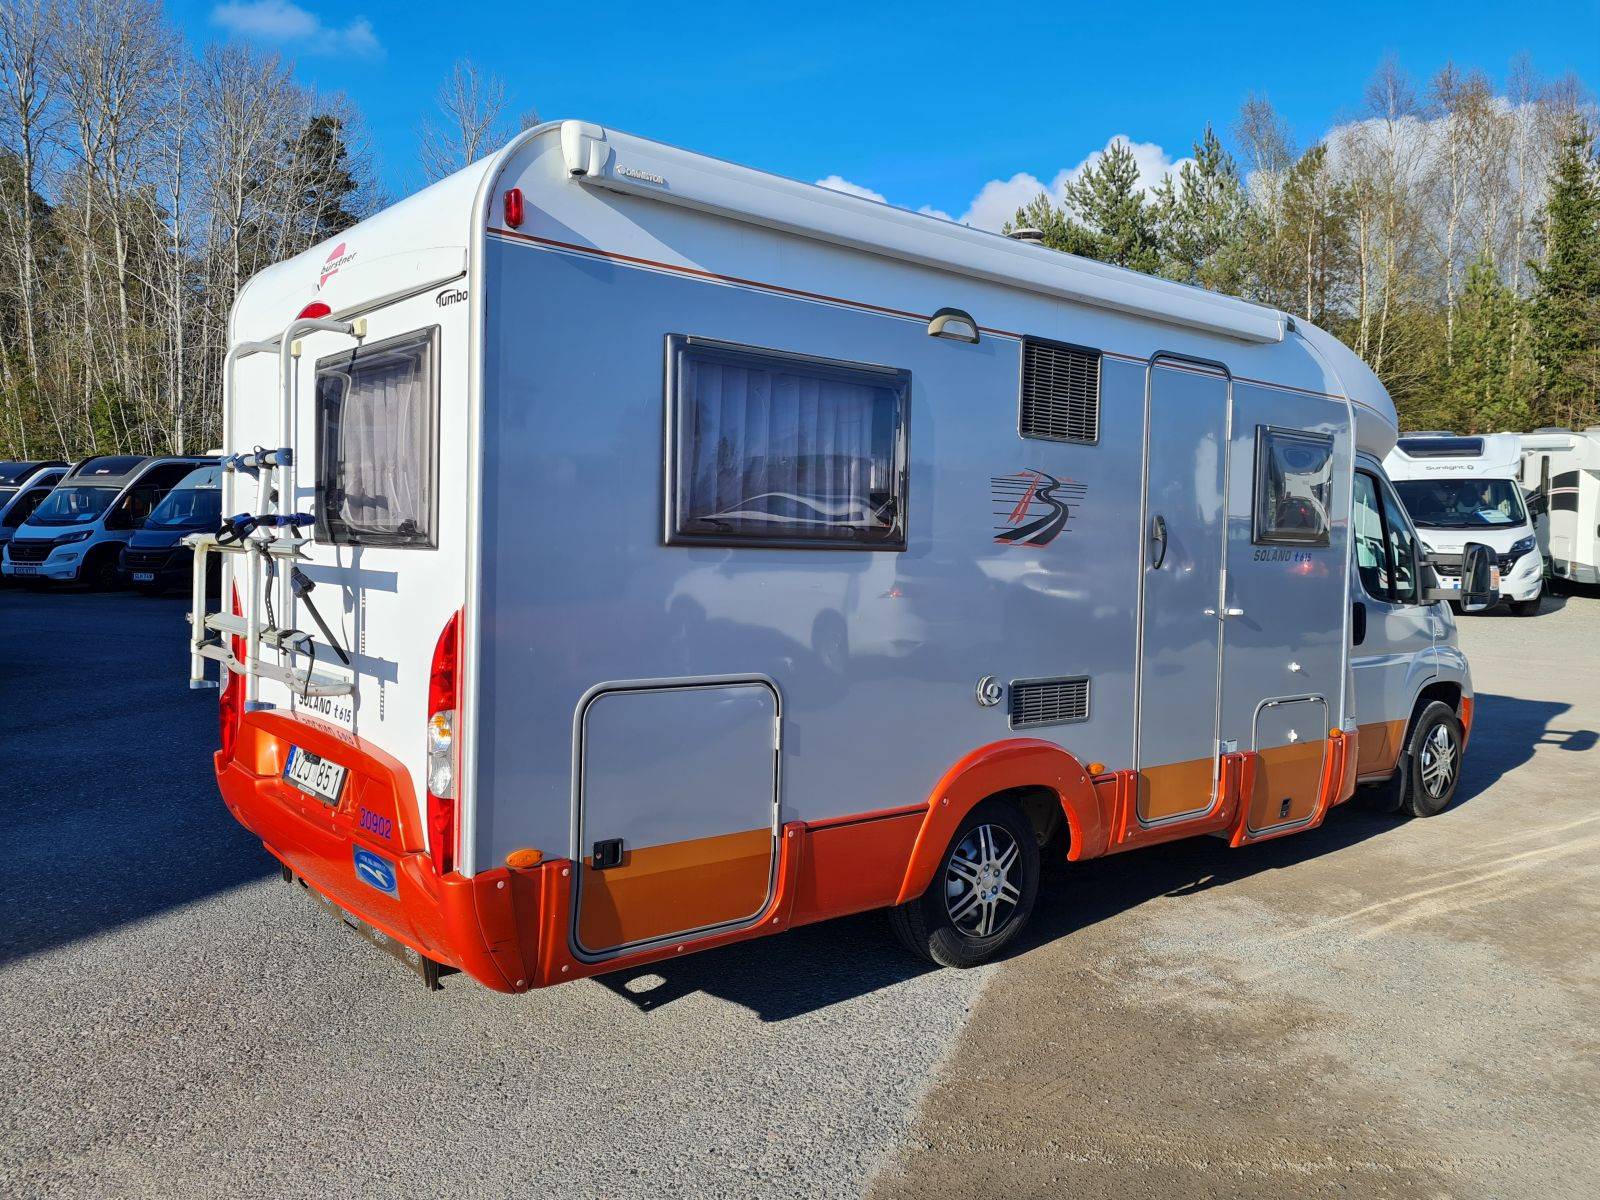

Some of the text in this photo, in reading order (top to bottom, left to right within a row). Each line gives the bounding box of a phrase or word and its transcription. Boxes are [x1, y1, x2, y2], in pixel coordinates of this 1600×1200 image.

[1253, 549, 1291, 562] SOLANO
[299, 693, 331, 715] SOLANO
[316, 762, 341, 795] 851
[360, 806, 392, 839] 30902
